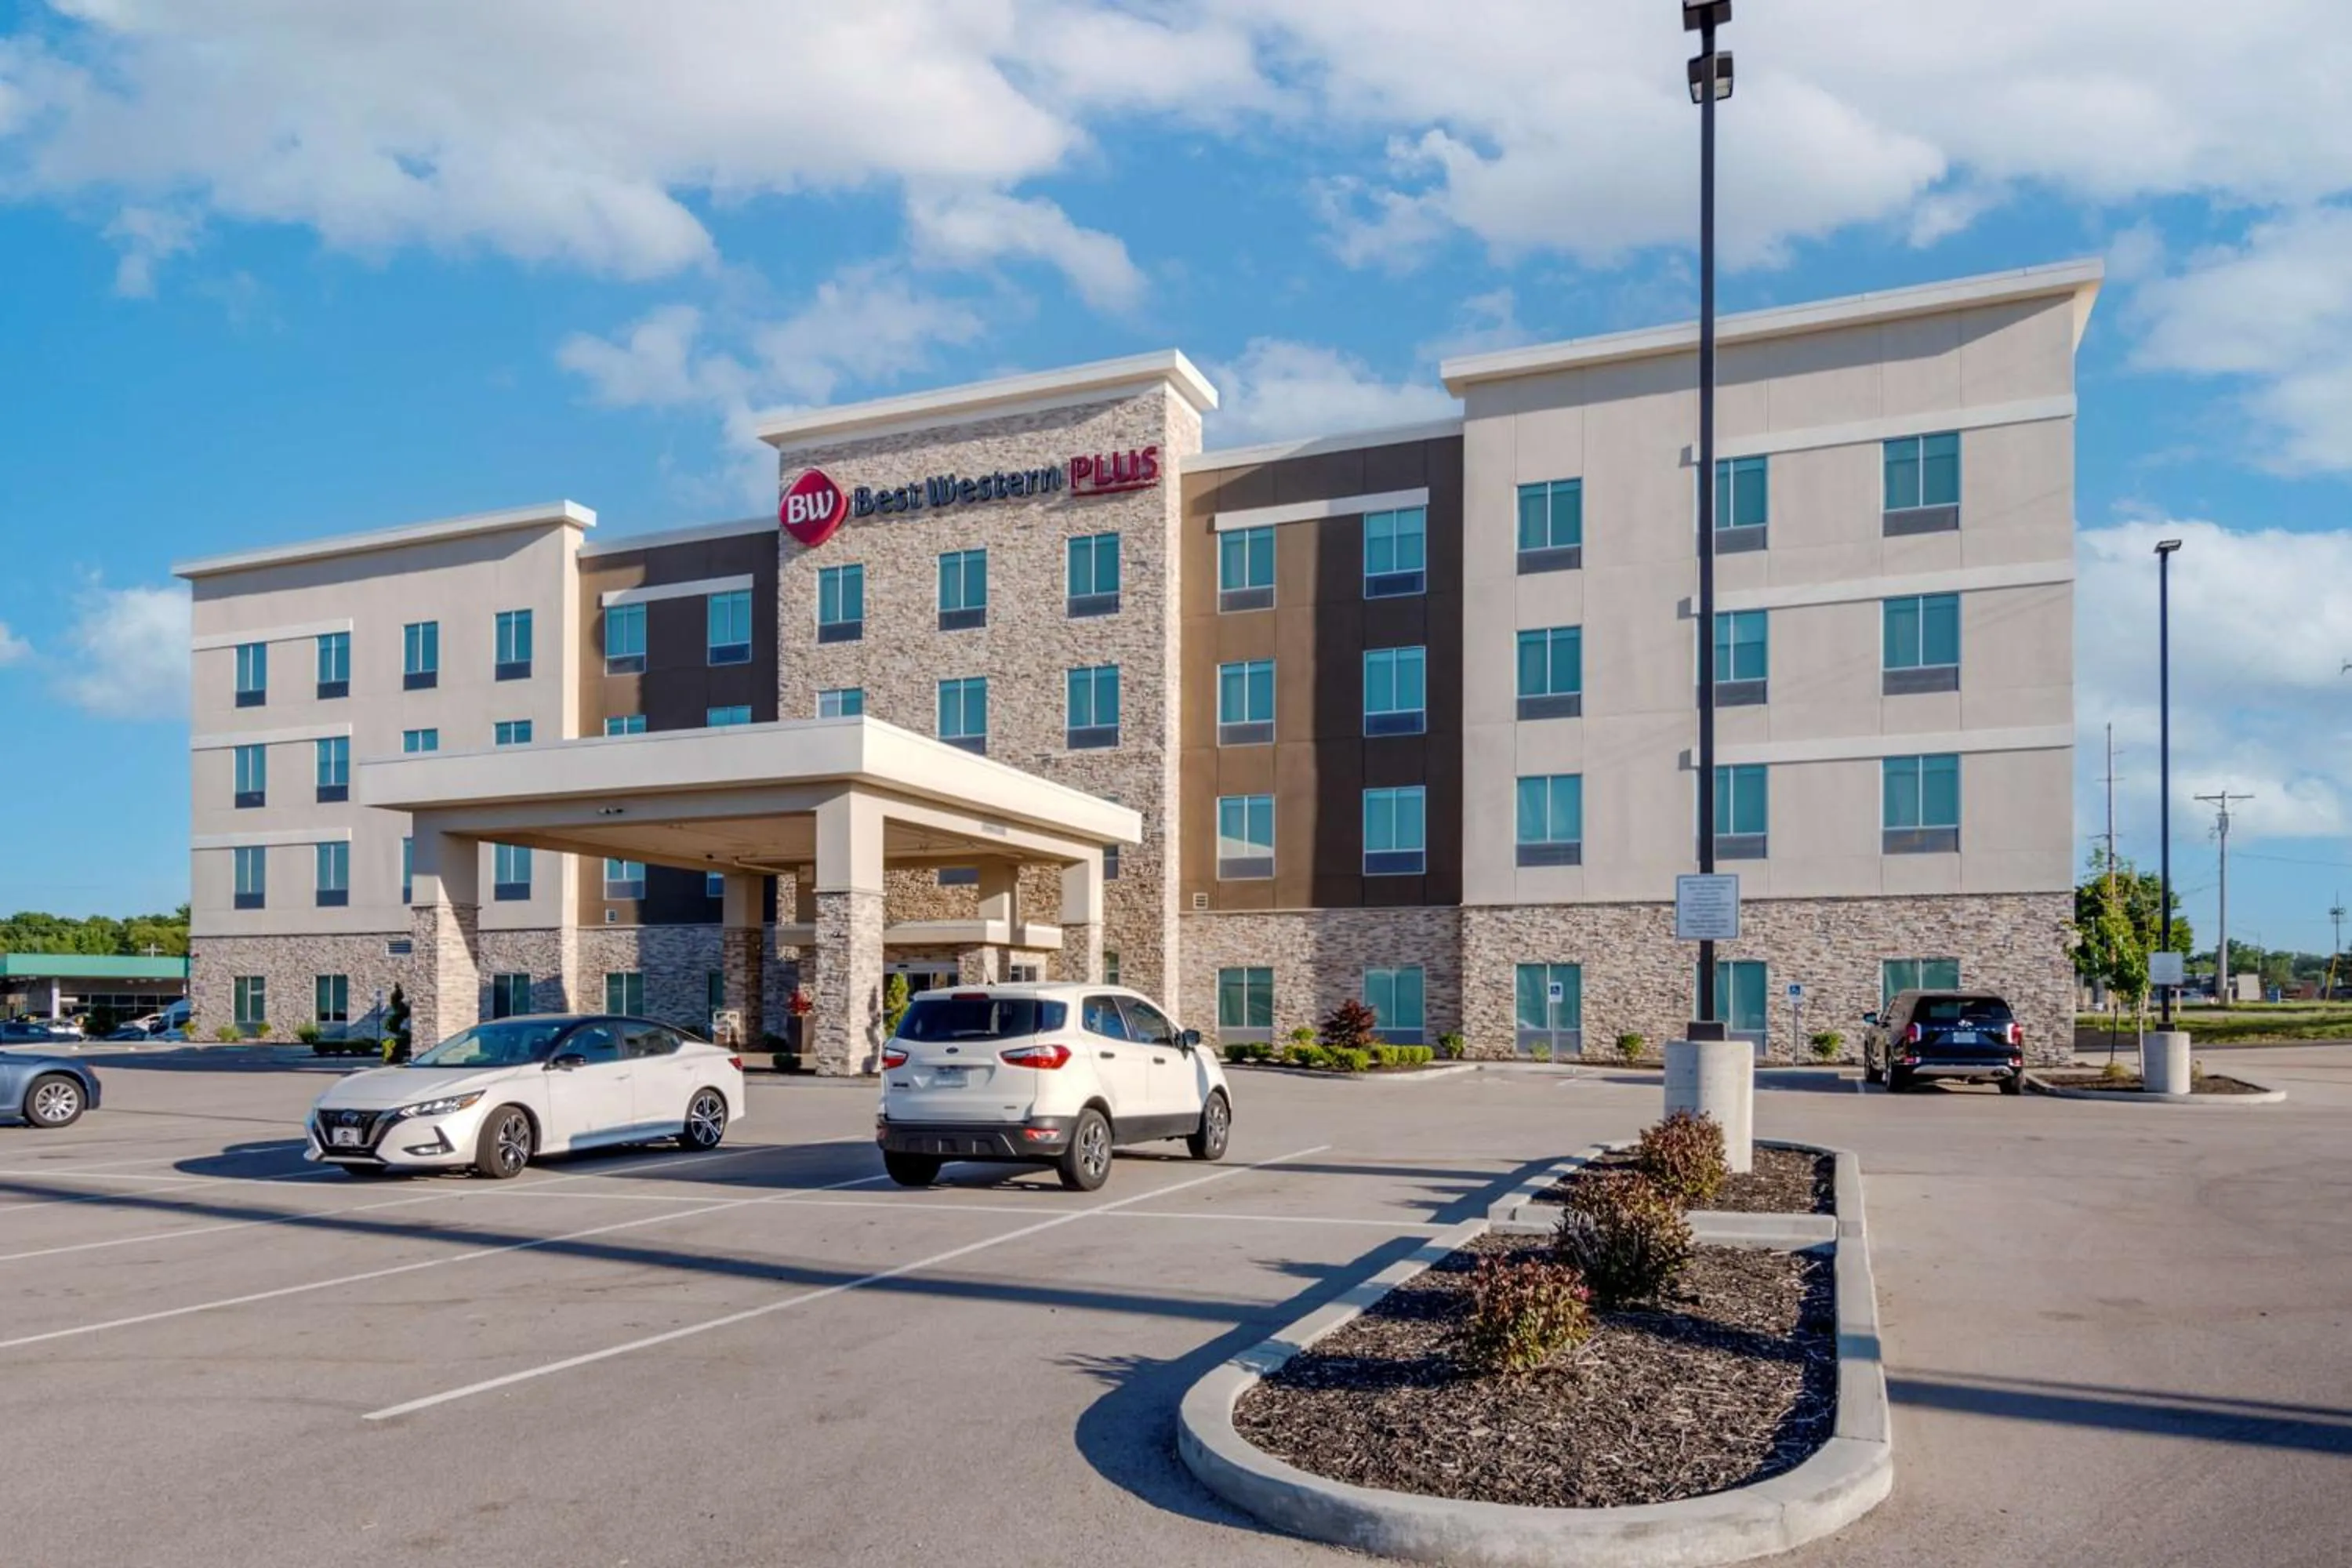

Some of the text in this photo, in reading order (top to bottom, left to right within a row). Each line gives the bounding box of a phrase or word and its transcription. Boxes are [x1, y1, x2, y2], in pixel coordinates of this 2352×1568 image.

[787, 489, 834, 524] BW
[854, 445, 1158, 517] Best Western PLUS
